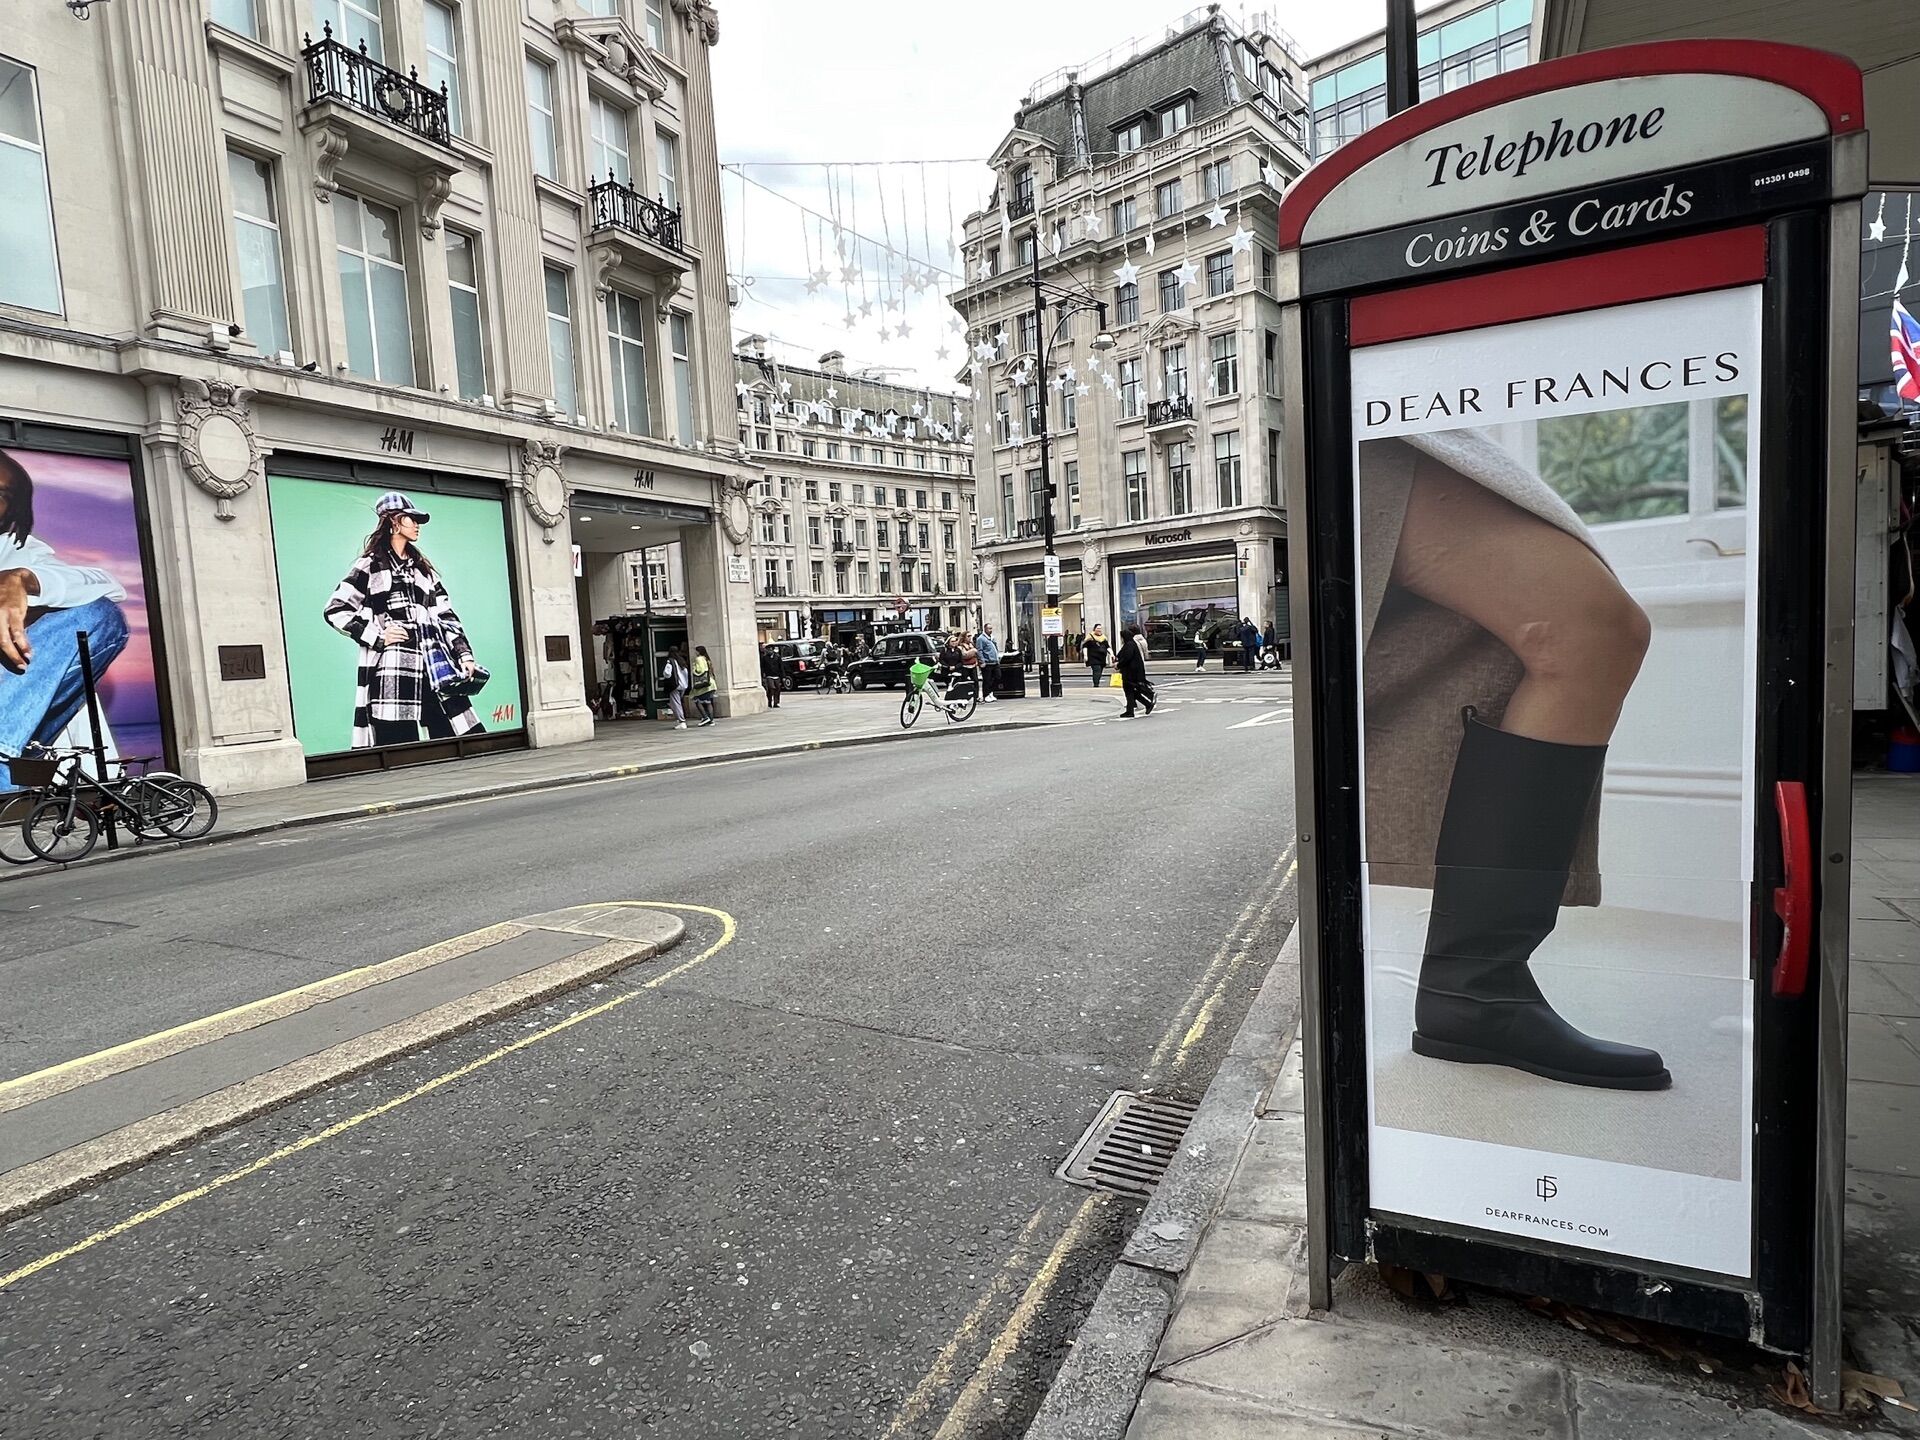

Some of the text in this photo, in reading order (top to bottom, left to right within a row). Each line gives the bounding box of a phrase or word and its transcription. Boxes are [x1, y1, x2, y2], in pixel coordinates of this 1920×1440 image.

[1425, 106, 1665, 188] Telephone
[1754, 173, 1786, 187] 013301
[1405, 183, 1694, 268] Coins & Cards
[1366, 352, 1740, 427] DEAR FRANCES
[380, 427, 414, 455] H&M
[634, 469, 654, 490] H&M
[1145, 529, 1192, 545] Microsoft
[492, 704, 514, 723] H&M
[1485, 1207, 1610, 1237] DEARFRANCES.COM
